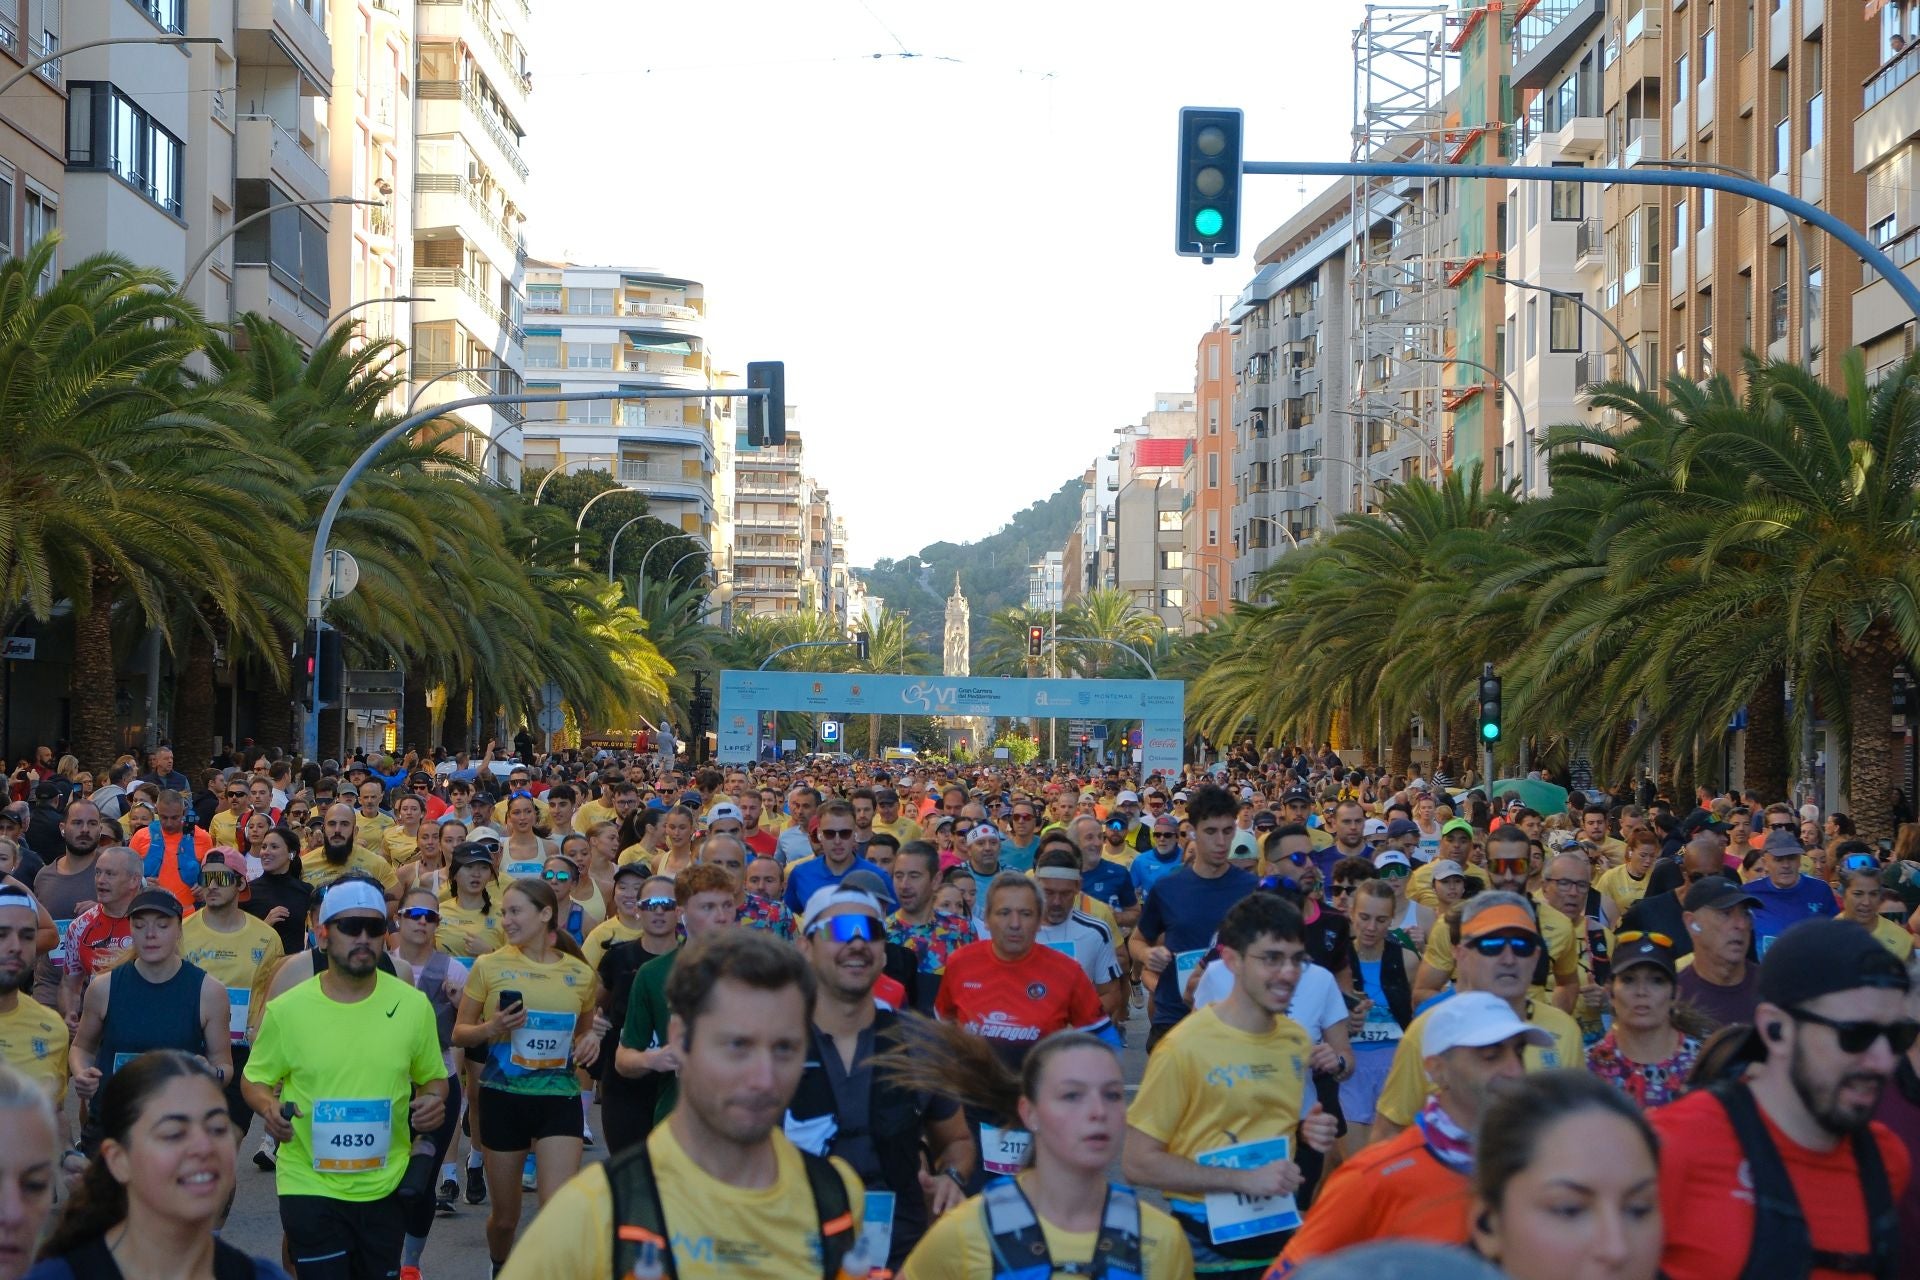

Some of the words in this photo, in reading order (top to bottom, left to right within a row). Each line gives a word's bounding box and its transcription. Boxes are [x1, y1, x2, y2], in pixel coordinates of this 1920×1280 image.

[824, 724, 836, 737] P
[1360, 1031, 1390, 1040] 4372
[526, 1039, 557, 1050] 4512
[330, 1133, 375, 1147] 4830
